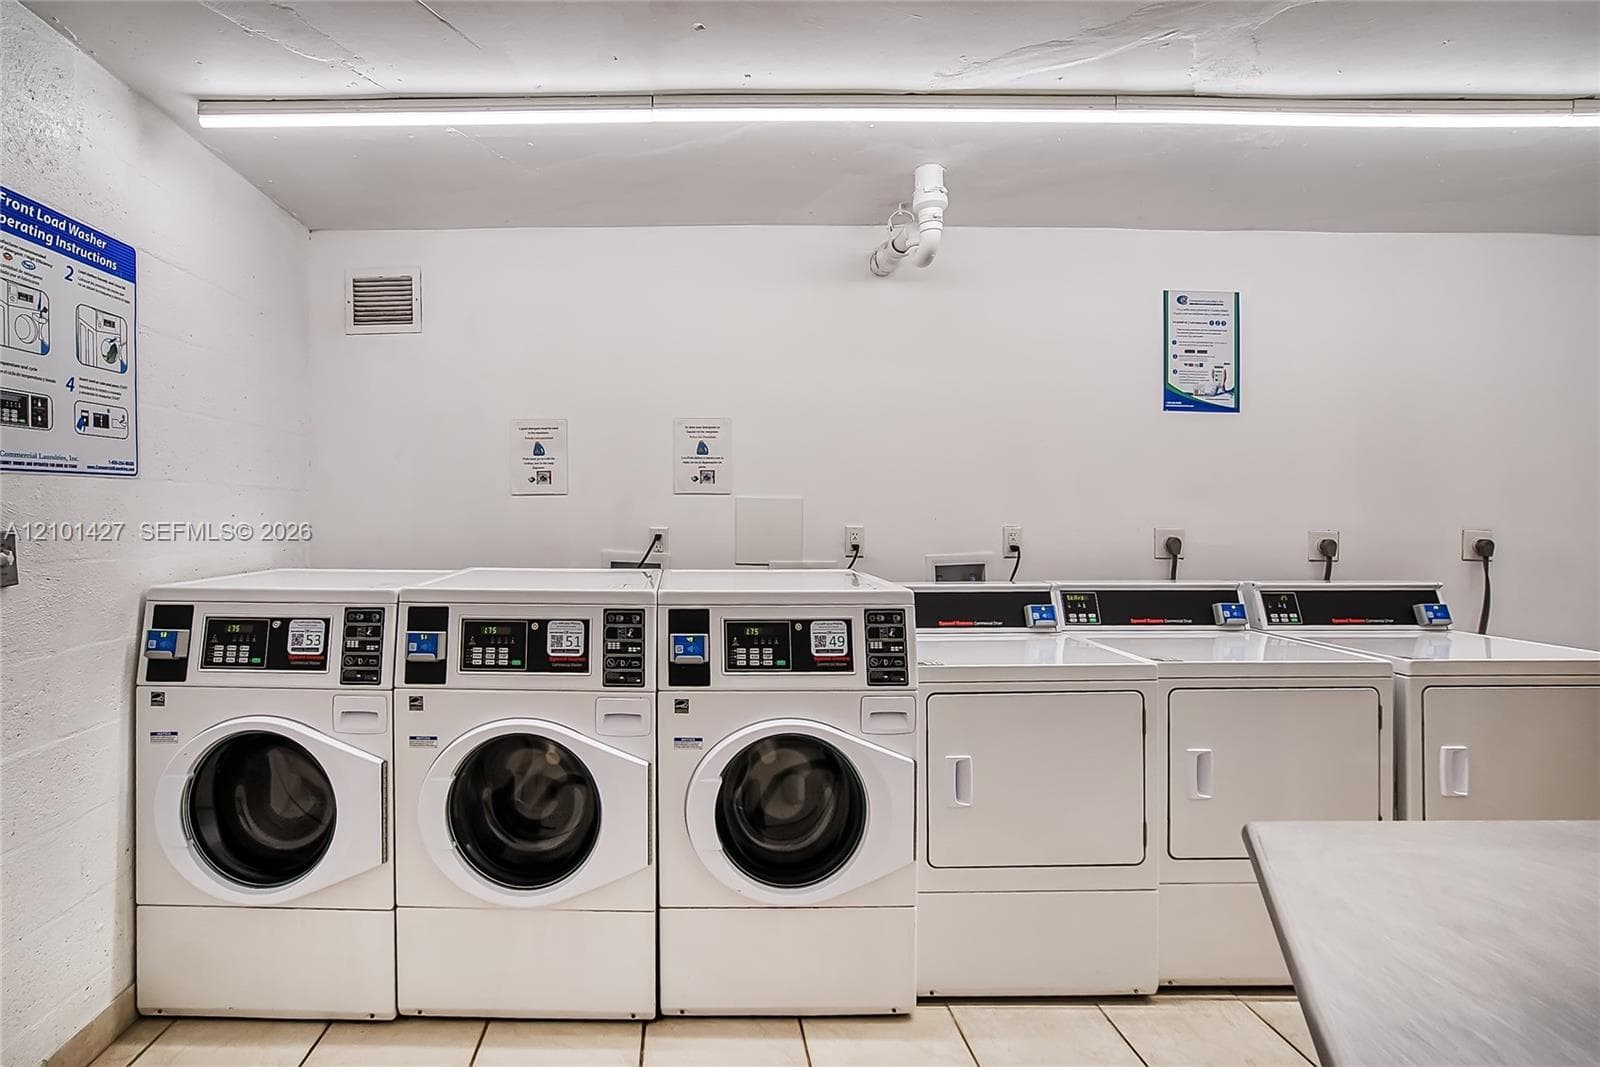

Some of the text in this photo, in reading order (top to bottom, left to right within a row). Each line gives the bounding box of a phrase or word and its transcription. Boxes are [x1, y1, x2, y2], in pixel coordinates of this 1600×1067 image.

[0, 191, 107, 249] Front Load Washer
[56, 235, 117, 270] Instructions
[64, 265, 74, 281] 2
[65, 377, 75, 392] 4
[305, 634, 321, 647] 53
[565, 635, 581, 648] 51
[829, 635, 845, 648] 49
